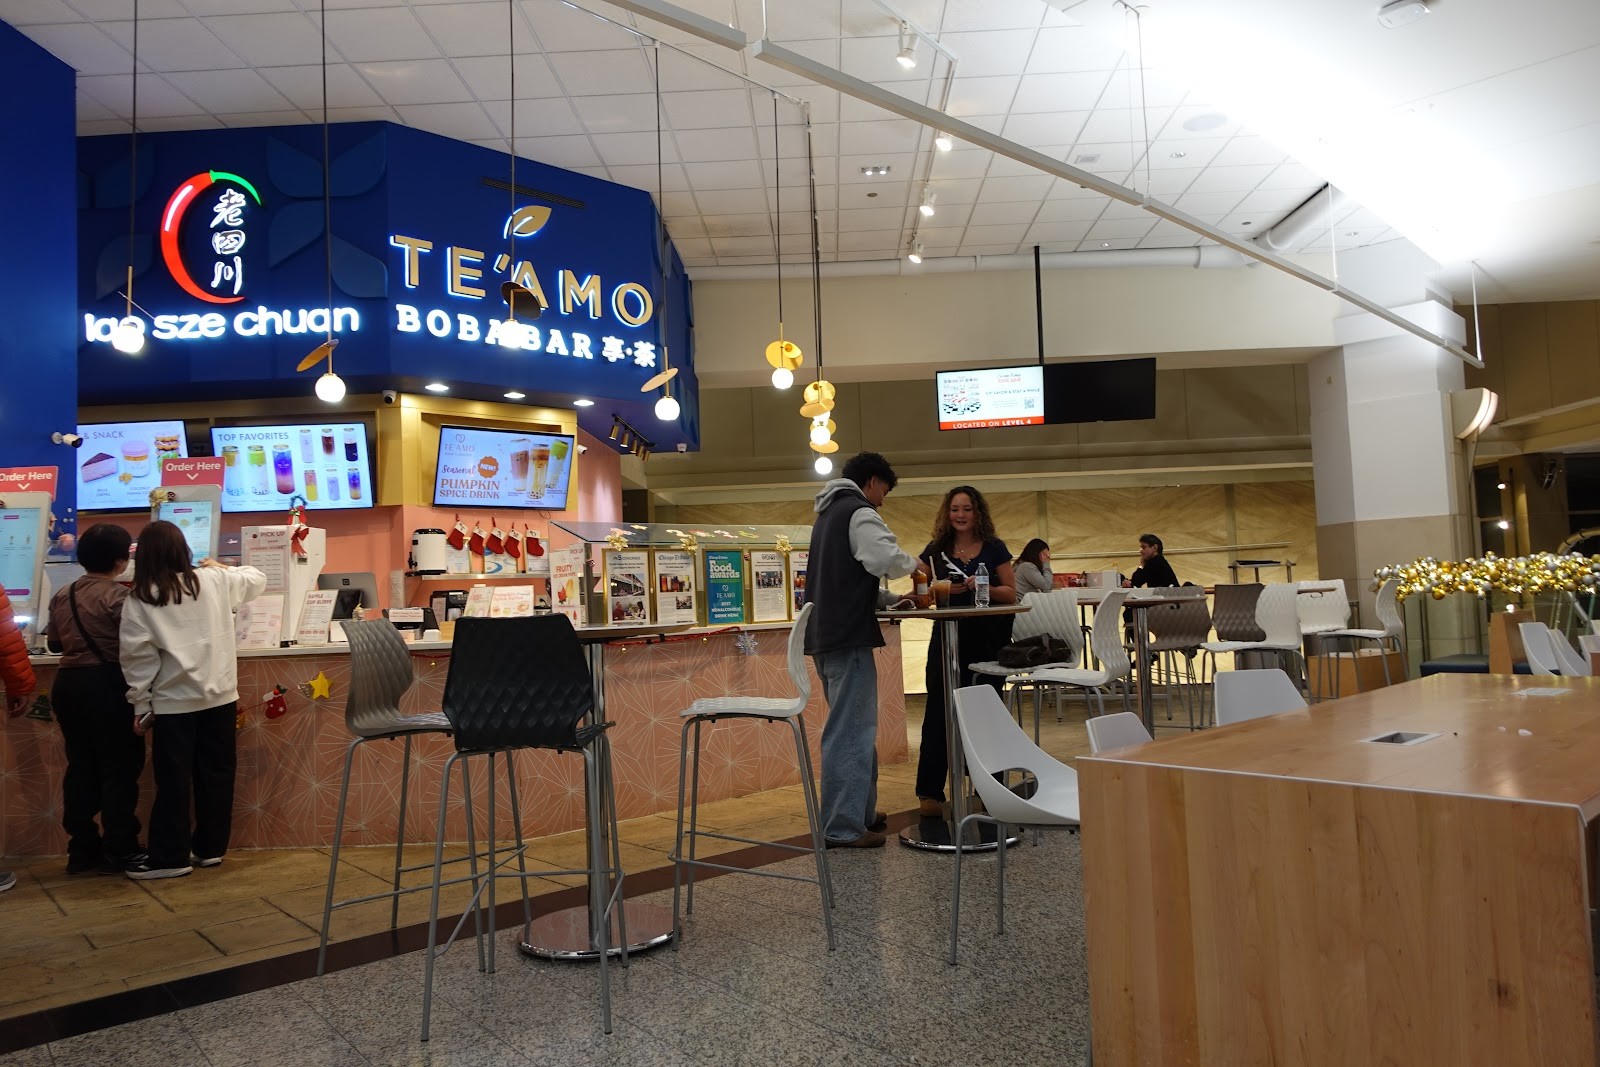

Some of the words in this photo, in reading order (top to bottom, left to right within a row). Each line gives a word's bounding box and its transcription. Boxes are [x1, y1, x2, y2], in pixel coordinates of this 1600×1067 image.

[210, 187, 247, 295] 老四川
[152, 312, 226, 340] sze
[233, 305, 359, 336] chuan
[517, 323, 593, 359] BAR
[953, 420, 986, 429] LOCATED
[1002, 419, 1024, 427] LEVEL
[92, 430, 125, 440] SNACK
[218, 433, 237, 442] TOP
[239, 431, 289, 442] FAVORITES
[165, 462, 195, 472] Order
[196, 461, 221, 471] Here
[441, 464, 476, 475] Seasonal
[28, 471, 53, 481] Here
[440, 478, 501, 491] PUMPKIN
[439, 488, 468, 498] SPICE
[469, 490, 501, 499] DRINK
[556, 564, 573, 573] FRUITY
[709, 559, 732, 573] Food
[709, 569, 740, 579] awards
